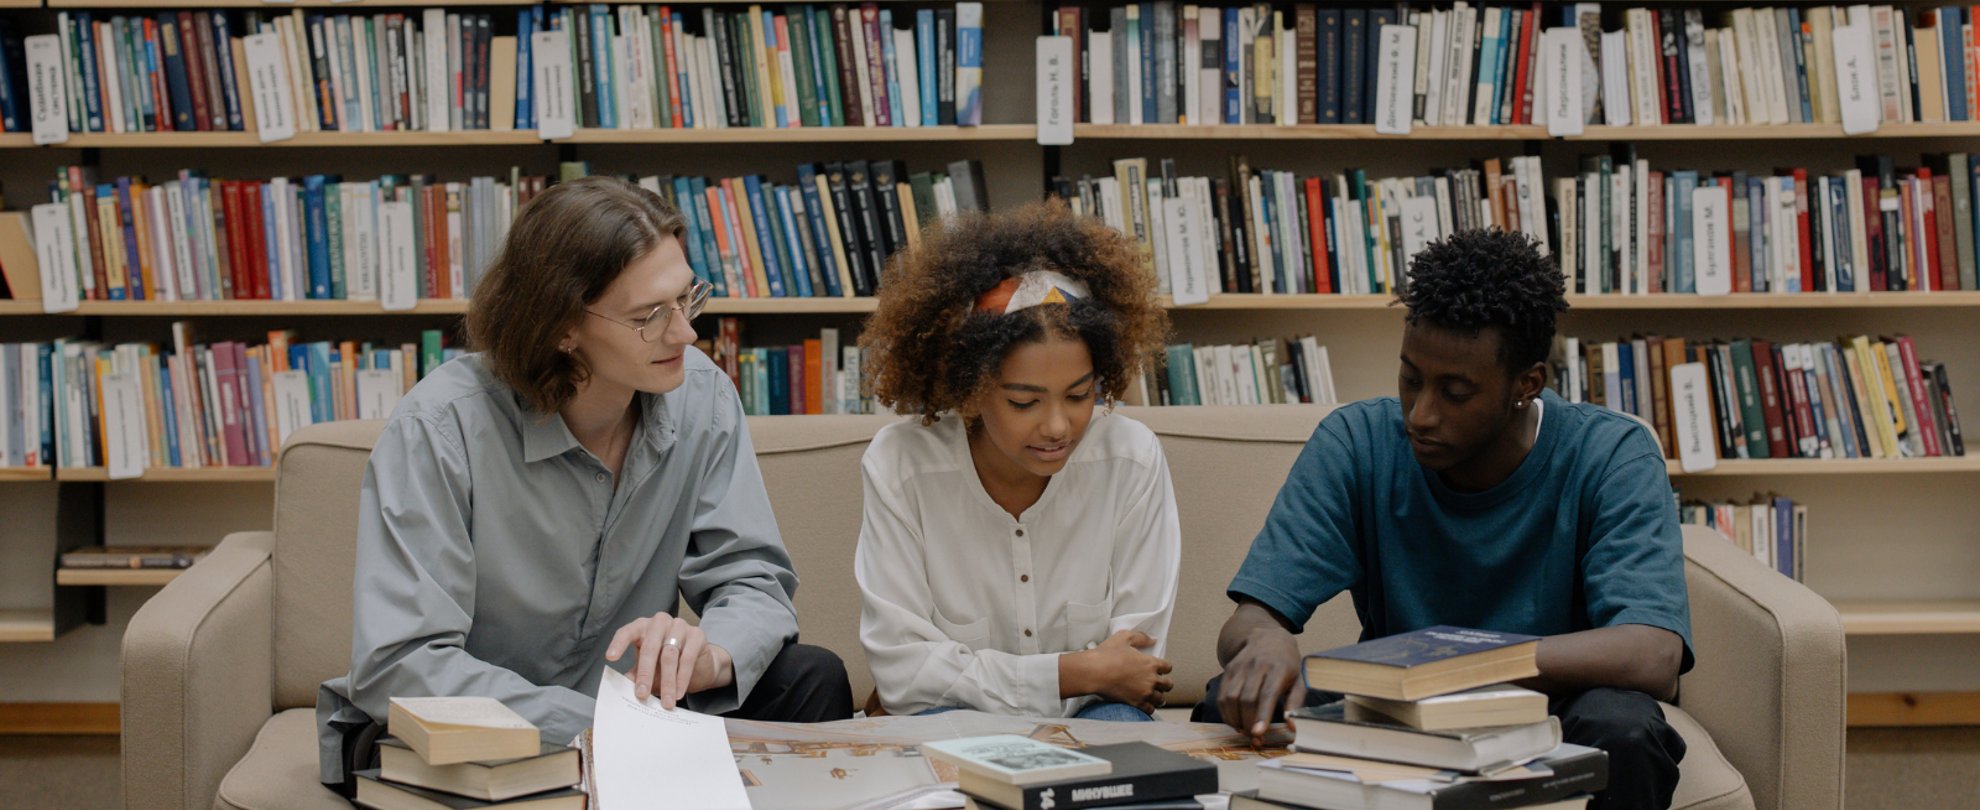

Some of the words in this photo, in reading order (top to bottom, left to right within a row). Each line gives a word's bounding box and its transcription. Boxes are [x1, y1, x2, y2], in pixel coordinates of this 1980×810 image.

[1048, 55, 1059, 66] В.
[1048, 70, 1059, 82] Н.
[1850, 72, 1861, 101] Блок
[1048, 85, 1059, 125] Гоголь
[1177, 204, 1186, 217] Ю.
[1413, 211, 1423, 223] С.
[1179, 221, 1188, 234] М.
[1705, 223, 1717, 277] Булгаков
[1182, 237, 1194, 295] Лермонтов
[1071, 783, 1134, 802] МИНУВШЕЕ
